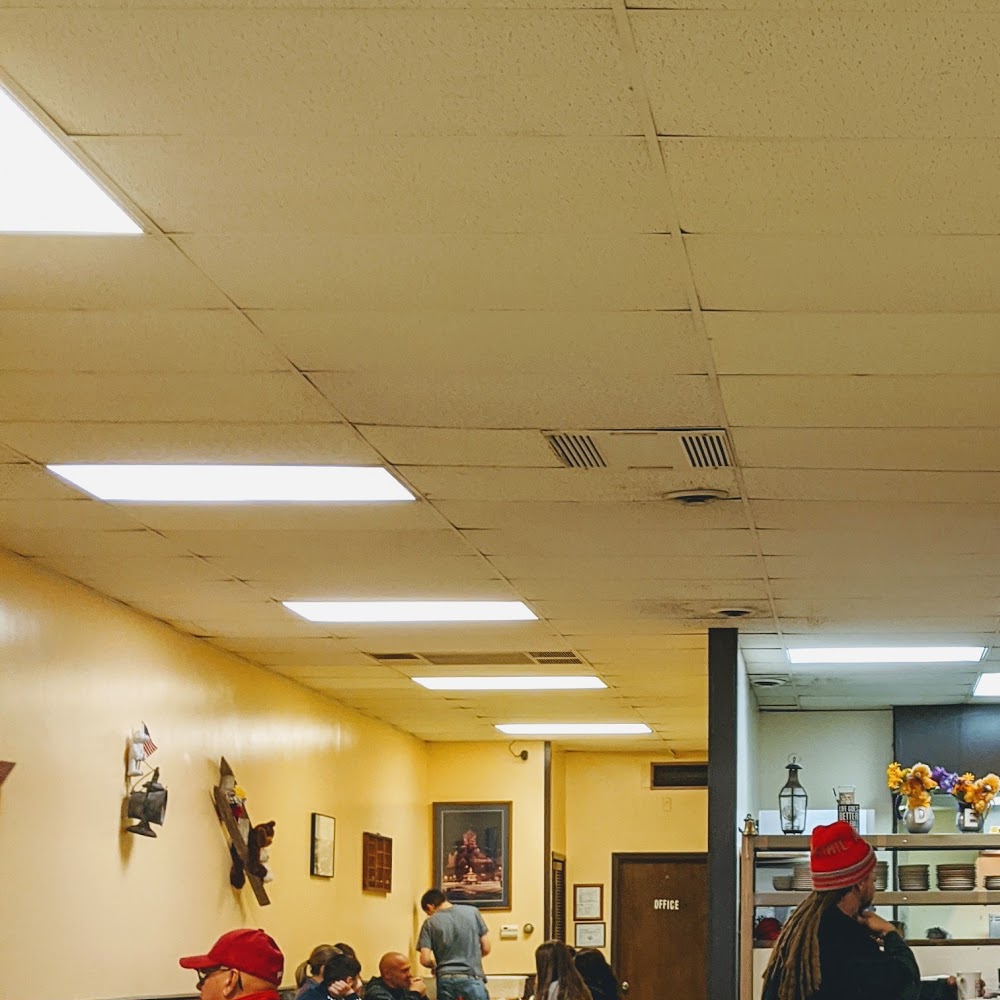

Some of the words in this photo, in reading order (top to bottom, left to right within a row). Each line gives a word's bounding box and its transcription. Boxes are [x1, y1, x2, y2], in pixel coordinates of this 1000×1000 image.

[839, 812, 858, 821] BETTER
[914, 808, 928, 823] D
[964, 808, 978, 827] E
[654, 899, 679, 910] OFFICE
